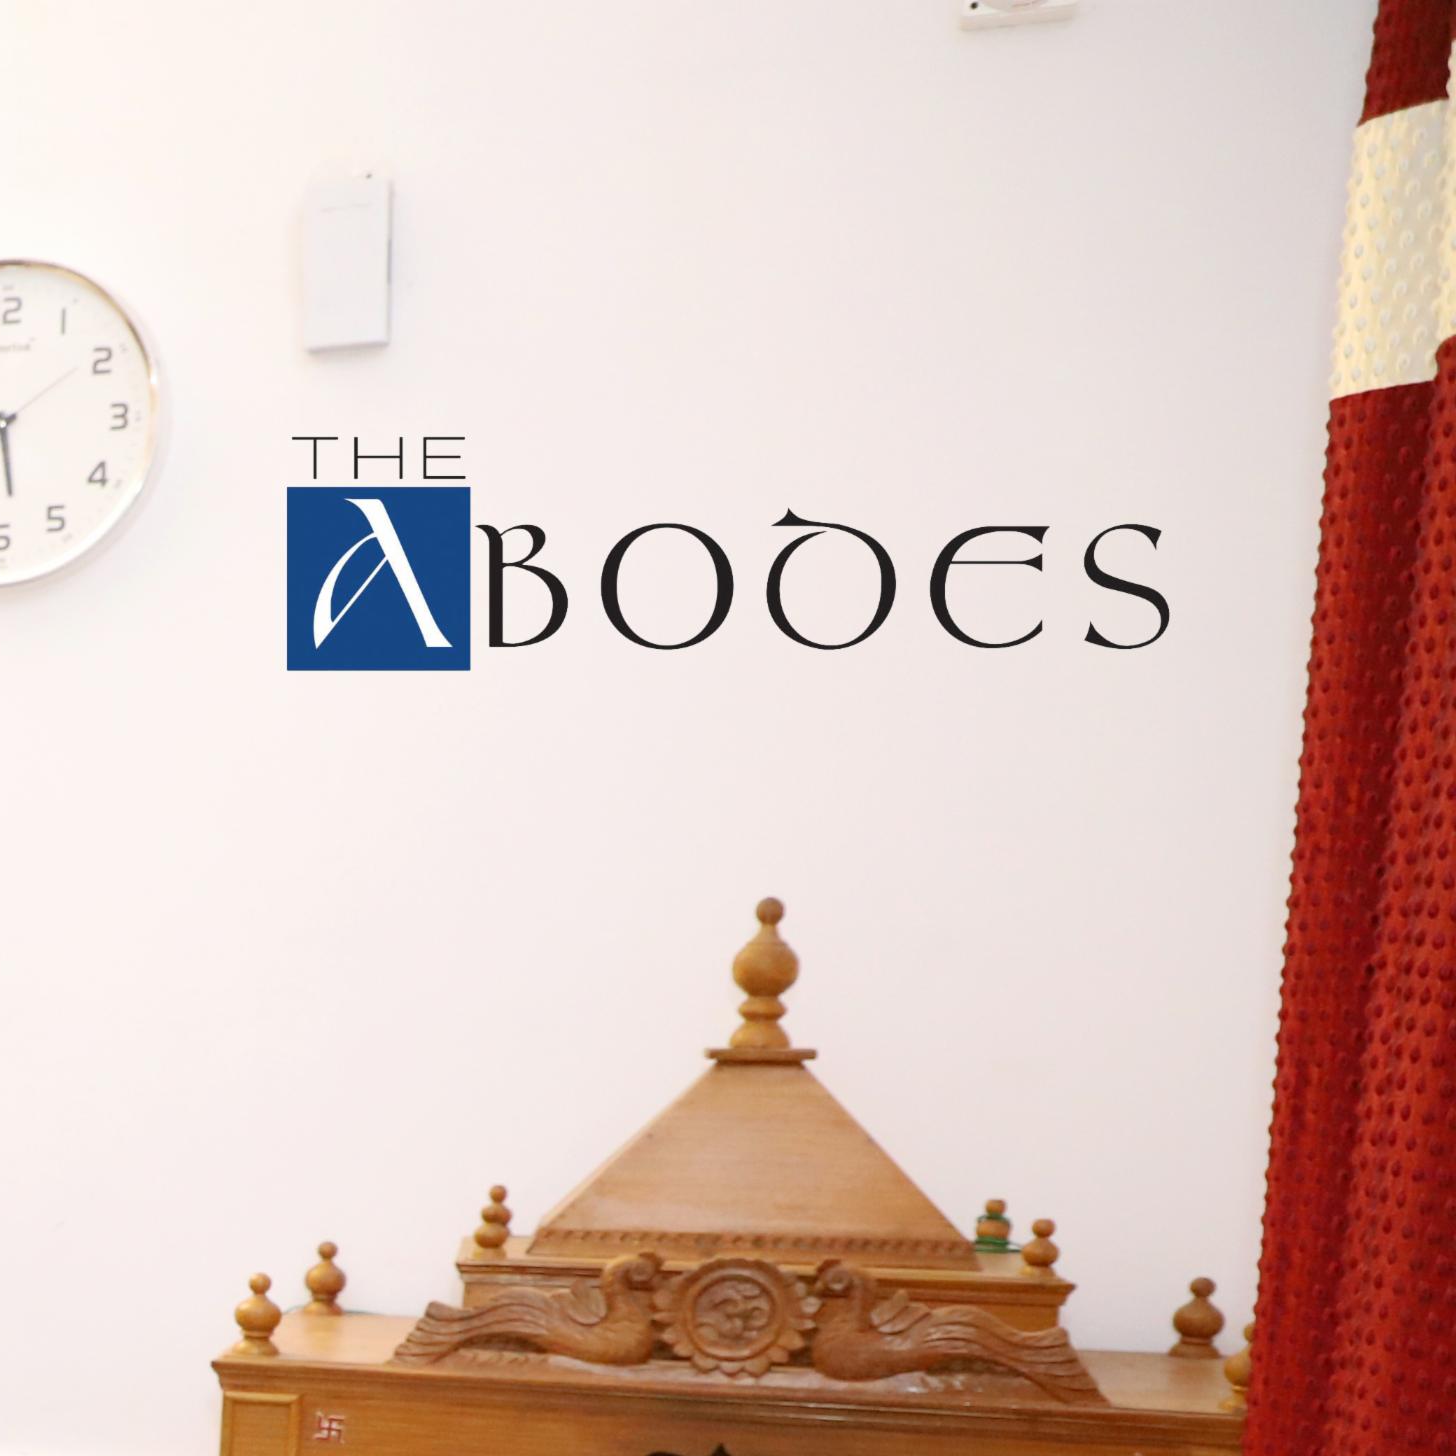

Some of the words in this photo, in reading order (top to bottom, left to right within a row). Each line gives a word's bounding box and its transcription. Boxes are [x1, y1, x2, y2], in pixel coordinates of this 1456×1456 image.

[92, 347, 113, 375] 2
[110, 403, 129, 430] 3
[87, 461, 109, 487] 4
[46, 505, 66, 532] 5
